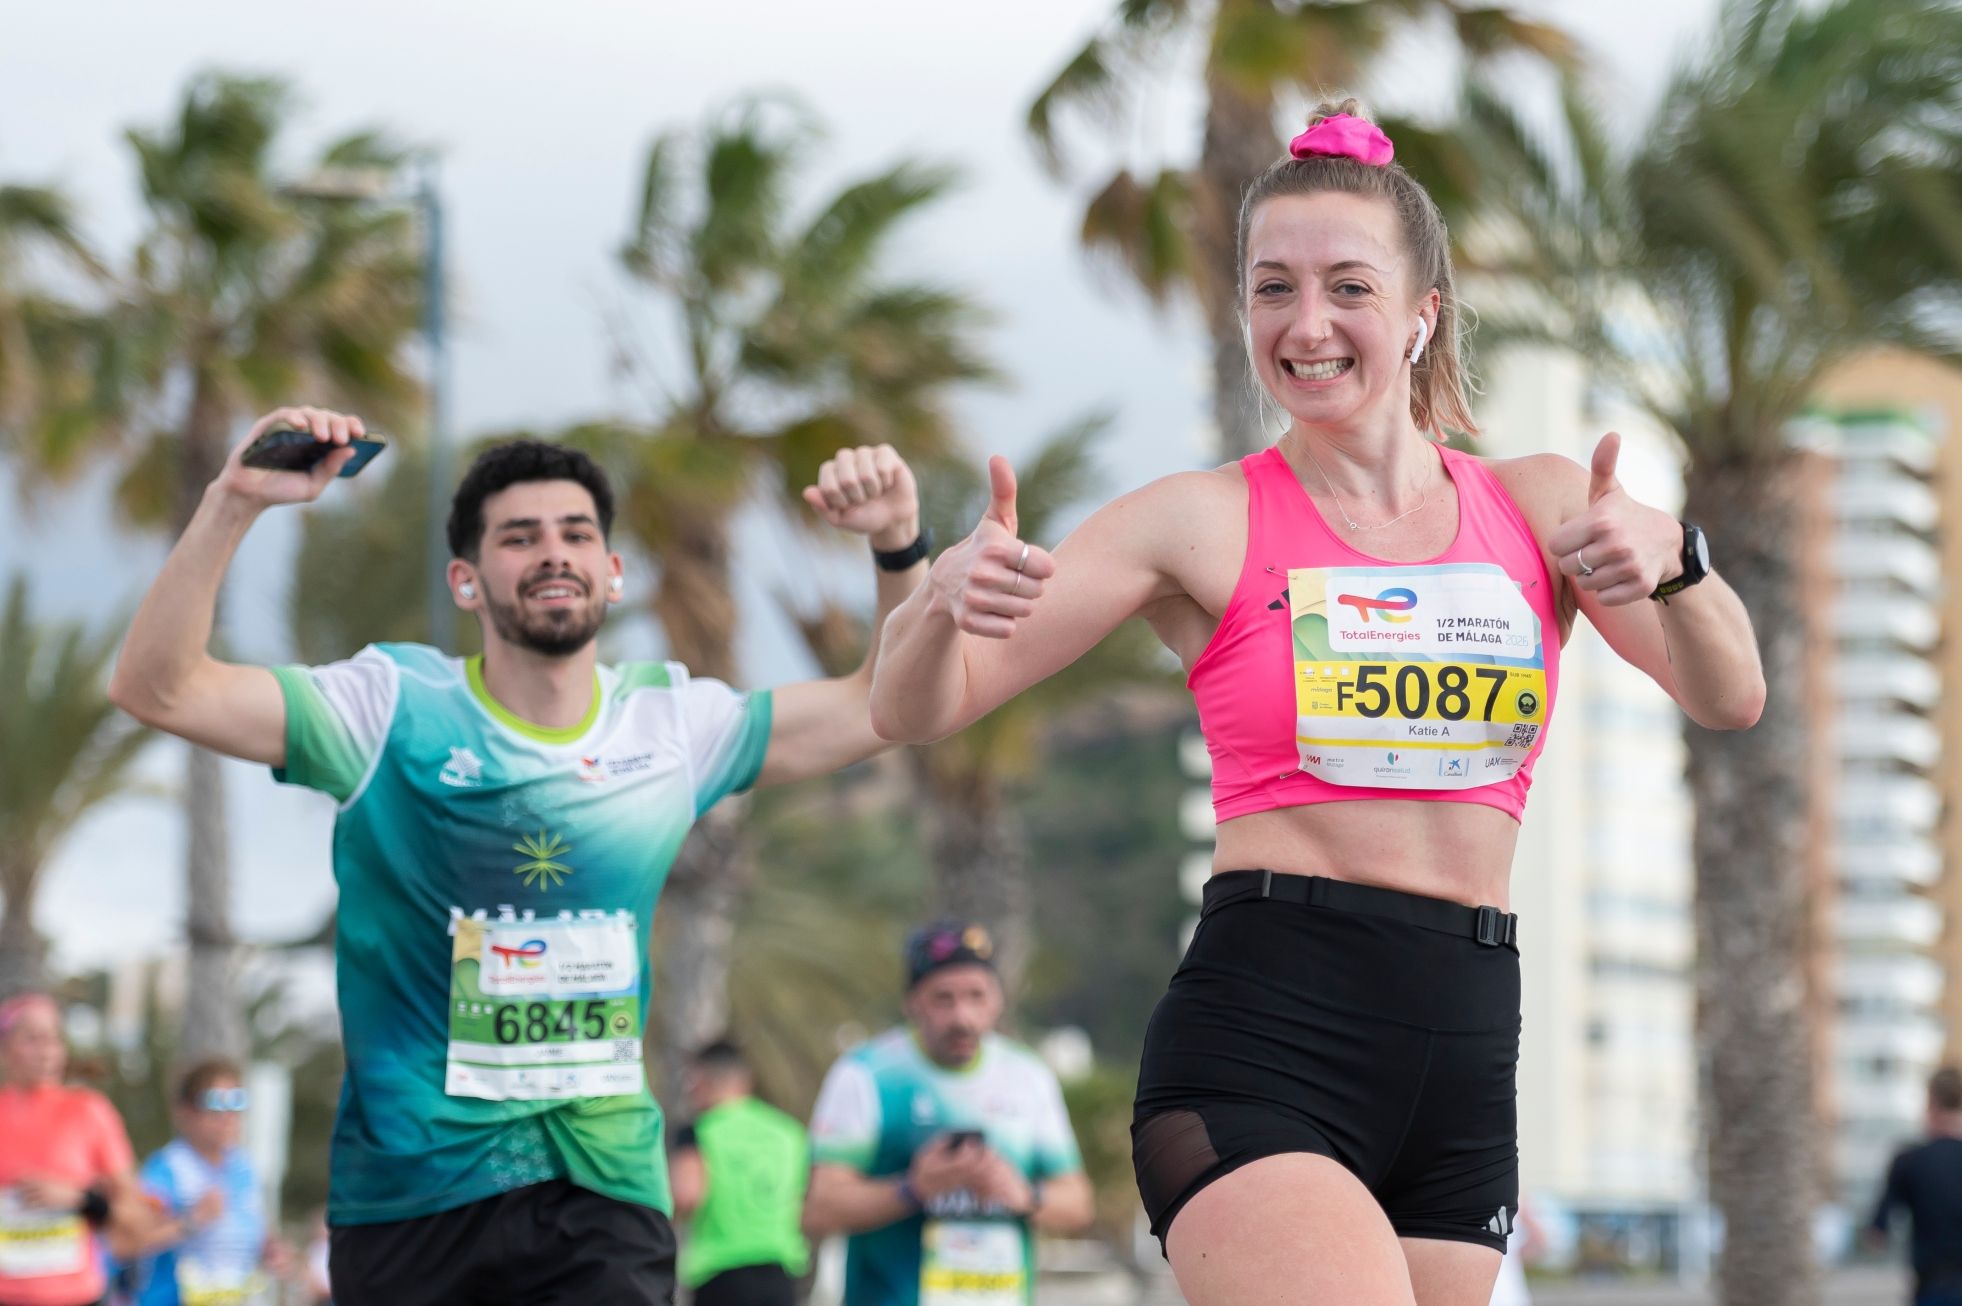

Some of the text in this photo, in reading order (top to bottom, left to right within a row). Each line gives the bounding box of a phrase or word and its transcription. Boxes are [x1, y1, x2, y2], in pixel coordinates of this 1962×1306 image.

[1436, 617, 1510, 630] 1/2 MARATÓN
[1339, 630, 1421, 642] TotalEnergies
[1437, 632, 1453, 642] DE
[1456, 630, 1502, 644] MÁLAGA
[1408, 725, 1450, 737] Katie A
[494, 1000, 608, 1044] 6845
